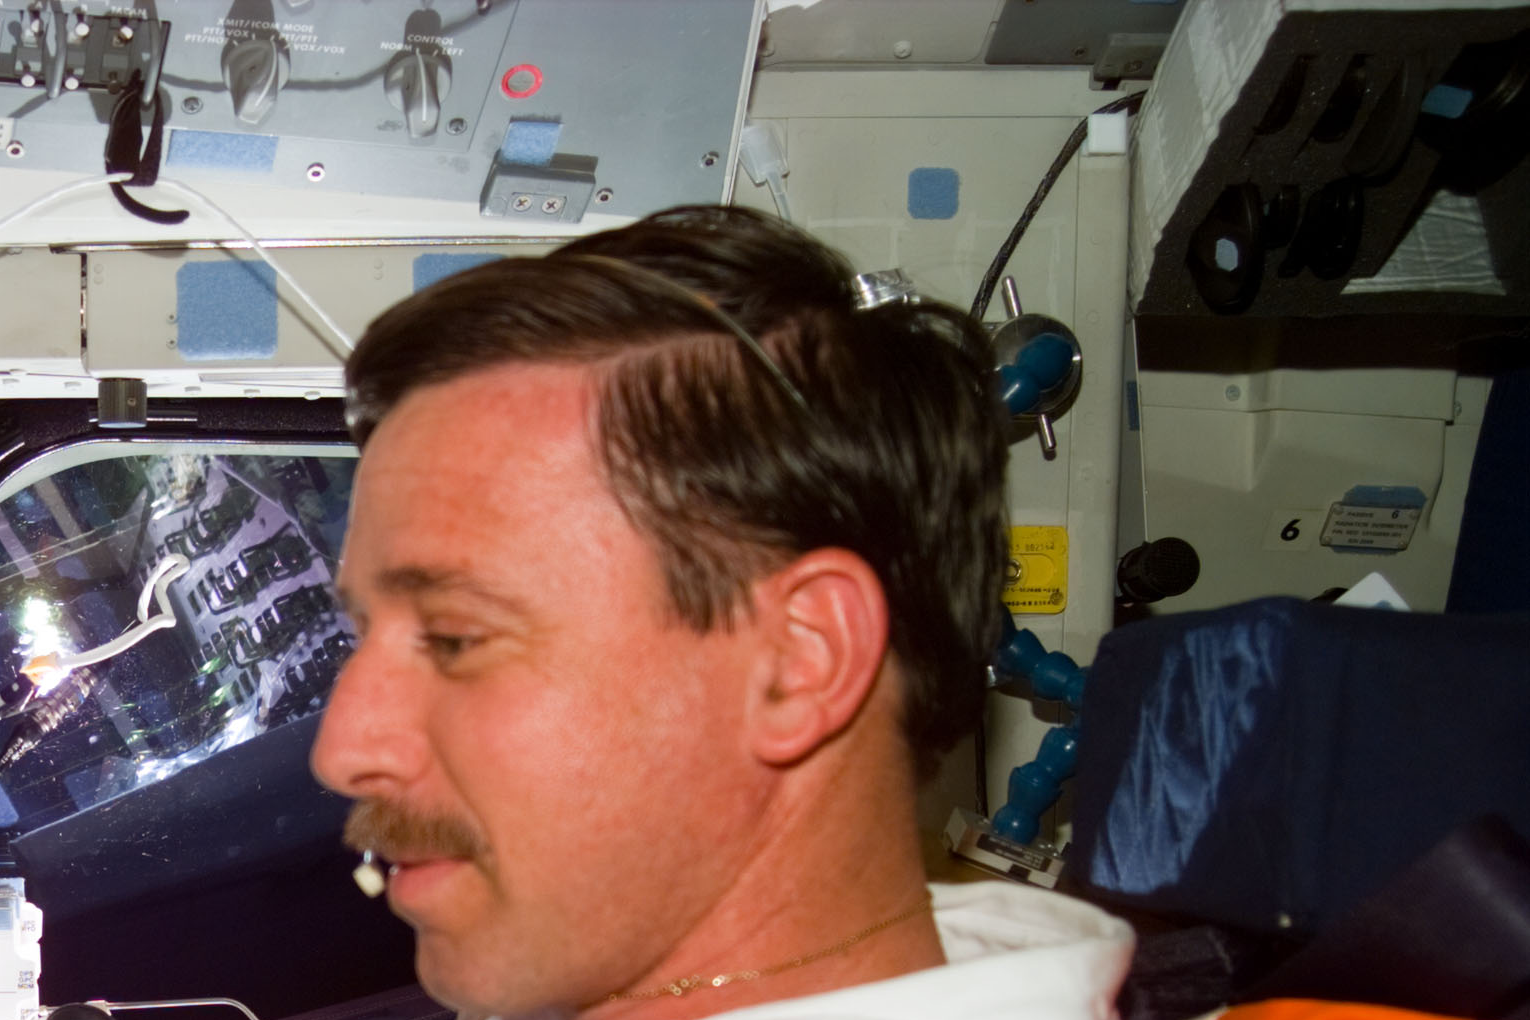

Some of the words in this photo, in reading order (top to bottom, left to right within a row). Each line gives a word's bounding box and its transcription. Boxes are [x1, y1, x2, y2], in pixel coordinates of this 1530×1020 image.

[217, 17, 280, 30] XMIT/ICOM
[283, 23, 315, 33] MODE
[203, 26, 250, 38] PTT/VOX
[380, 41, 413, 51] NORM
[407, 34, 454, 46] CONTROL
[293, 43, 346, 55] VOX/VOX
[442, 47, 465, 56] LEFT
[1391, 510, 1400, 520] 6
[1281, 519, 1302, 541] 6
